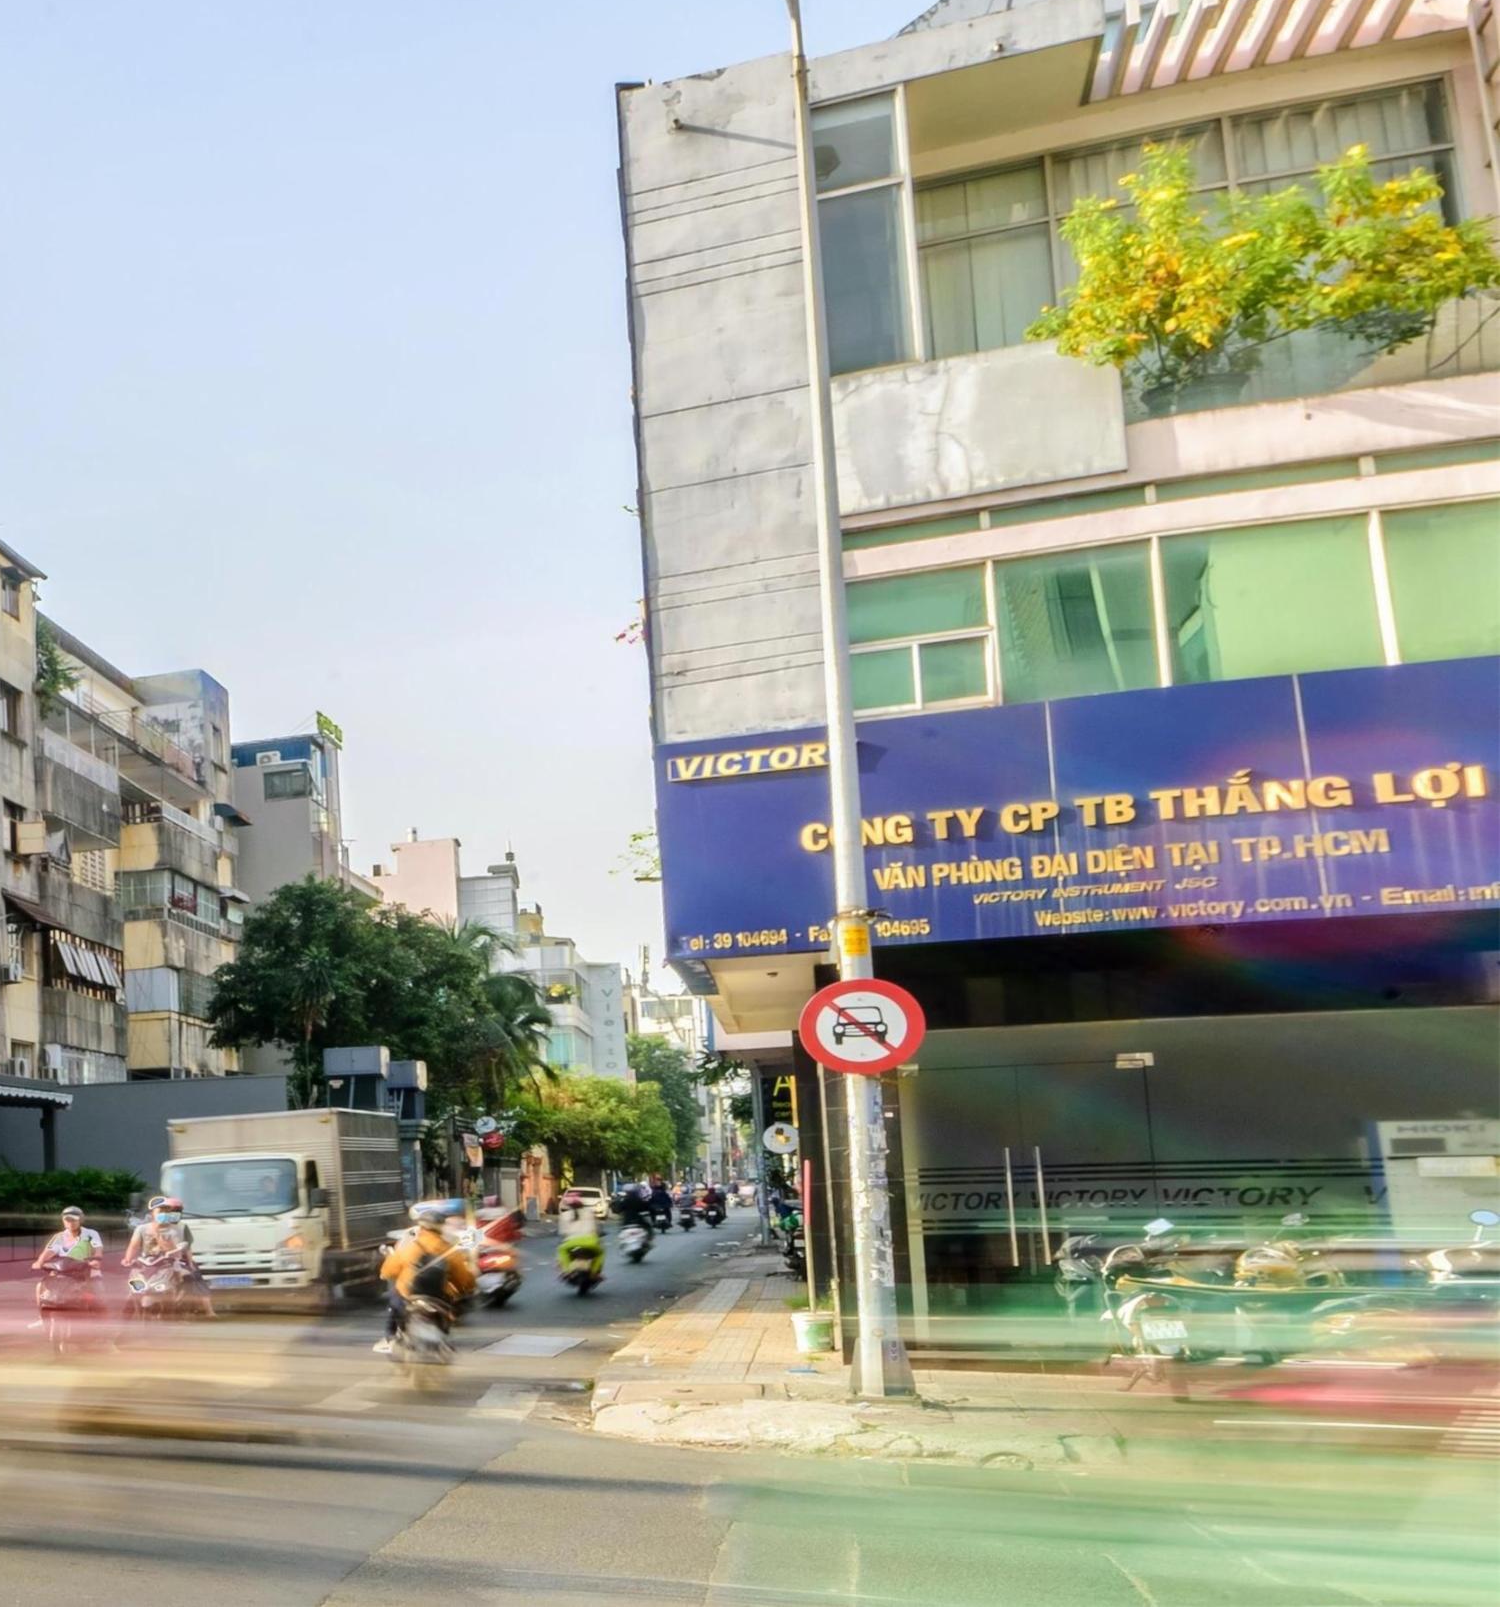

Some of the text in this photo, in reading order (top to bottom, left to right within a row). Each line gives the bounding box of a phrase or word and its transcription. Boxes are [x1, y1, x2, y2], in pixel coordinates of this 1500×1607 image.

[675, 742, 831, 780] VICTOR
[801, 762, 1487, 852] CNG TY CP TB THẮNG LỢI
[873, 828, 1390, 891] VĂN PHÒNG ĐẠI DIỆN TẠI TP.HCM
[973, 876, 1218, 904] VICTORY INSTRUMENT JSC
[736, 929, 787, 948] 104694
[1161, 1186, 1324, 1206] VICTORY
